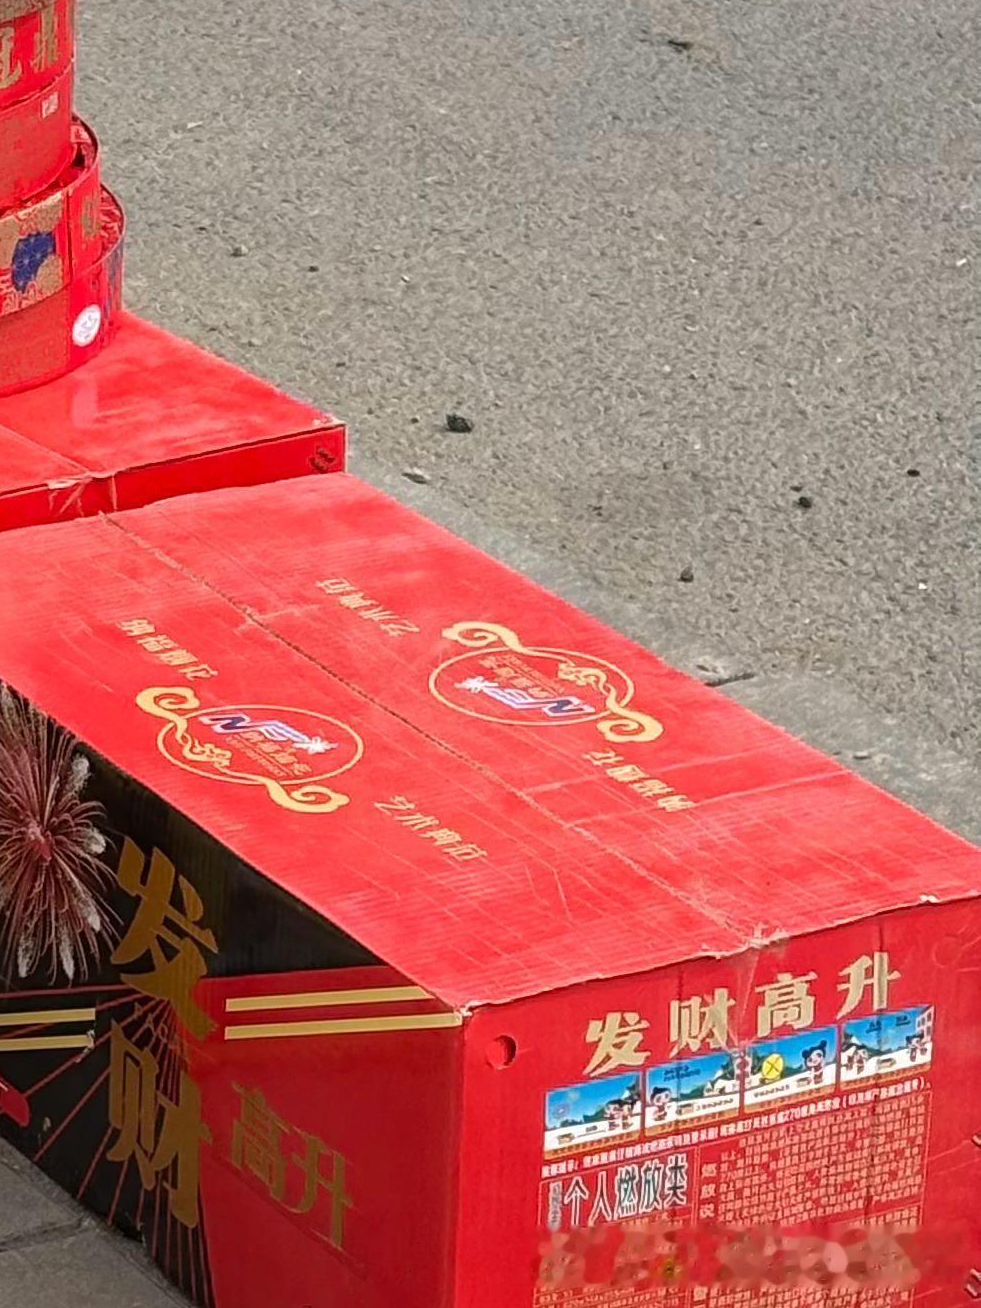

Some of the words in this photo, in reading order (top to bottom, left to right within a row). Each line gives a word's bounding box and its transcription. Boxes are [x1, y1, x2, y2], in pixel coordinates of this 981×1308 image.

[583, 951, 902, 1079] 发财高升
[563, 1153, 689, 1228] 个人燃放类
